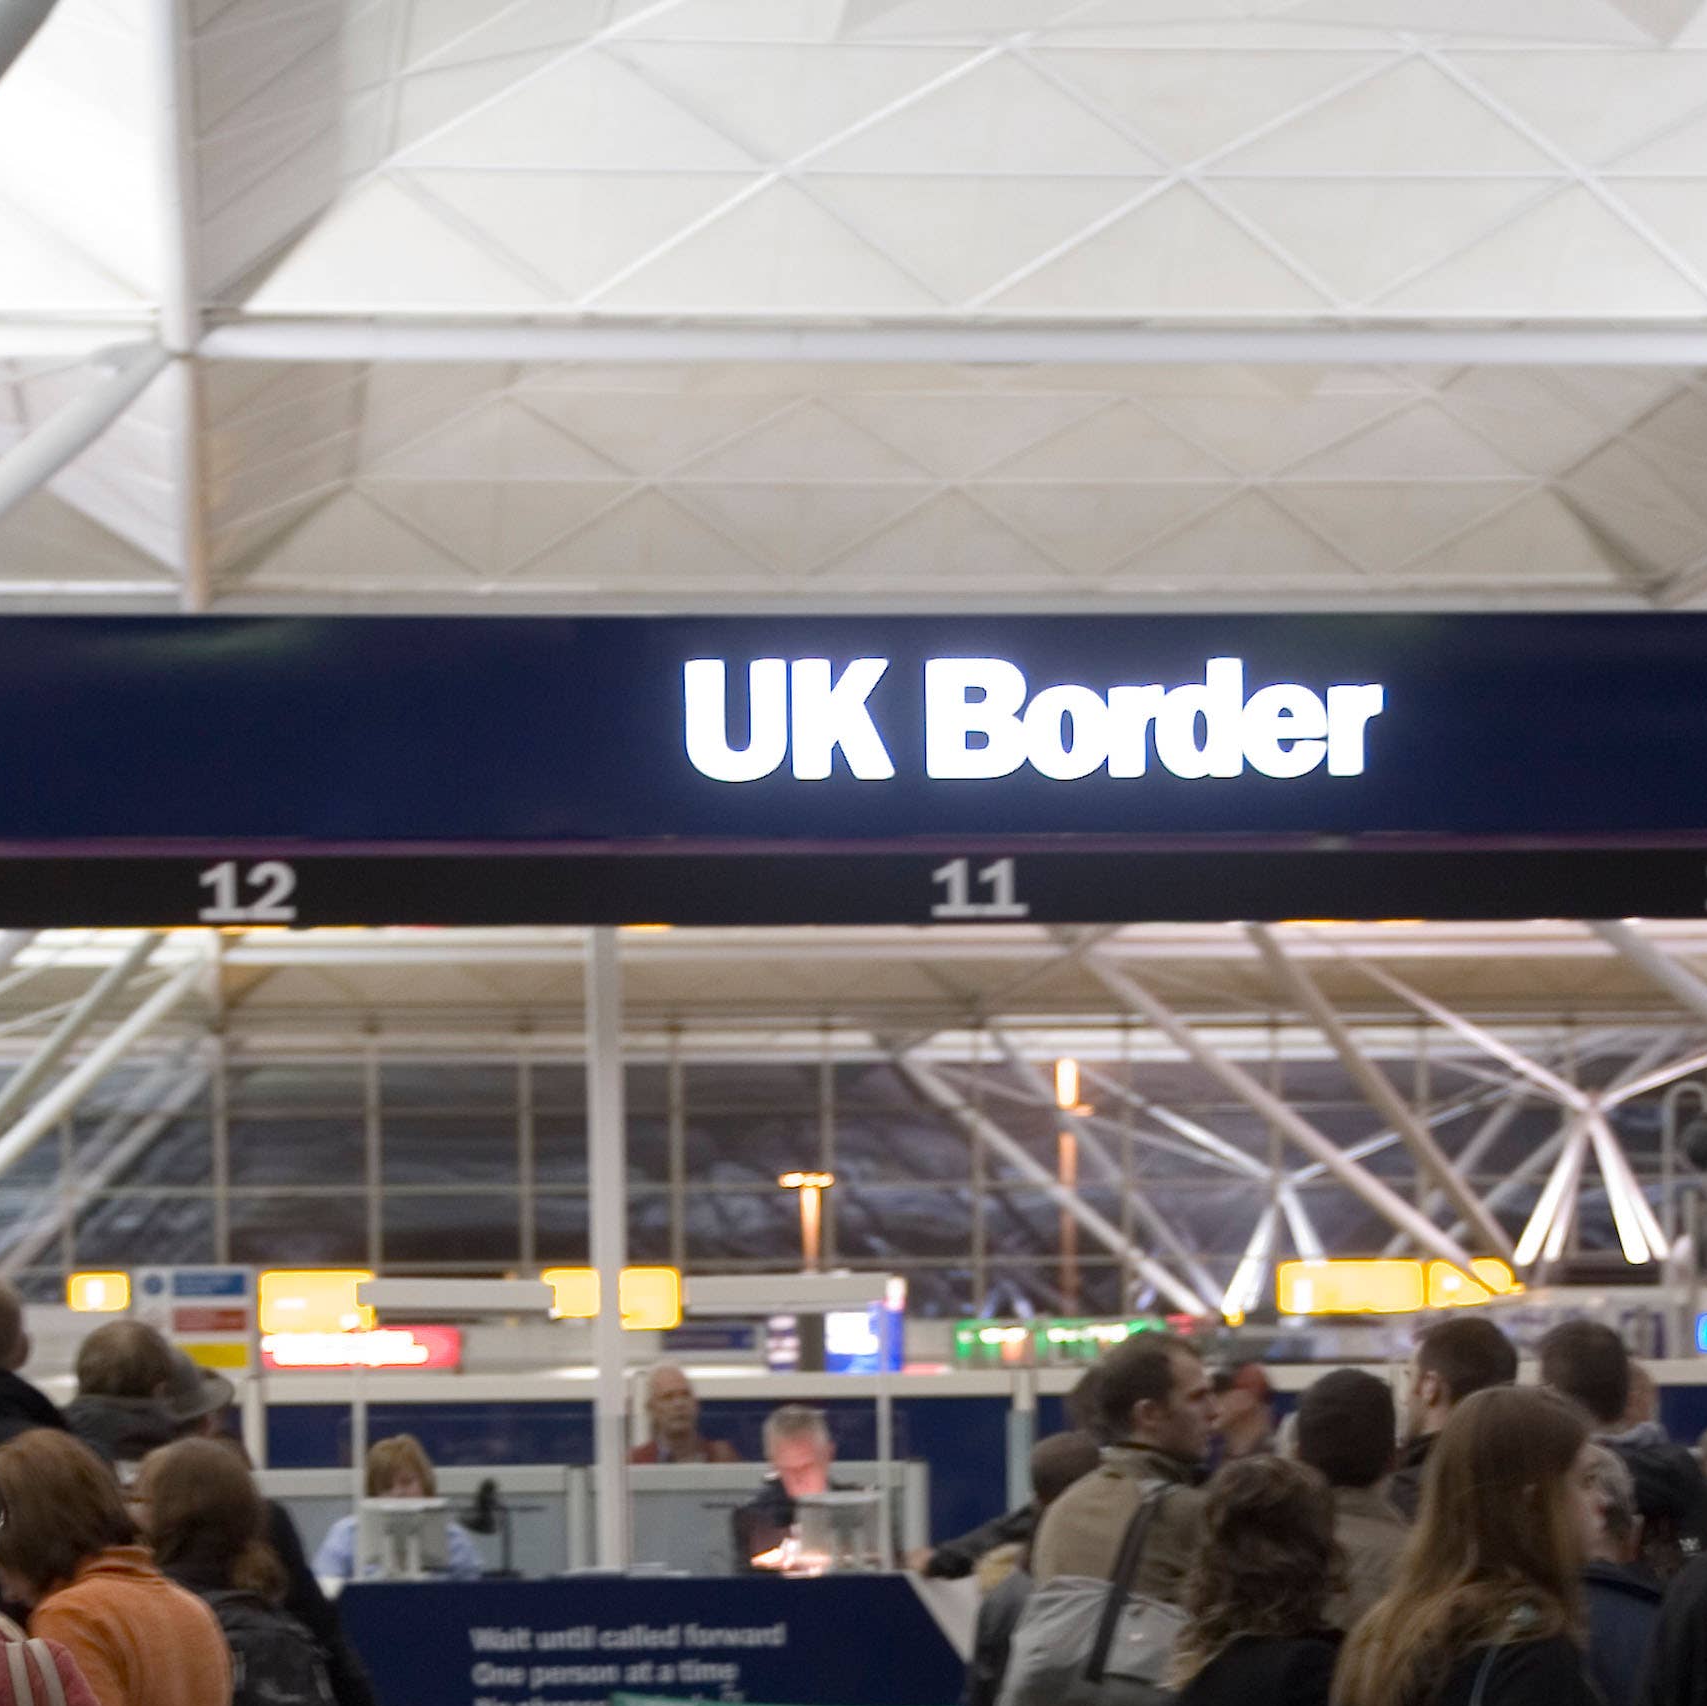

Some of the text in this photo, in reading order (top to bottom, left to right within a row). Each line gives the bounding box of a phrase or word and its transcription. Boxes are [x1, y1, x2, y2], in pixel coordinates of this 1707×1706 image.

[684, 656, 1385, 783] UK Border
[198, 860, 297, 923] 12
[930, 857, 1030, 919] 11
[469, 1622, 787, 1651] Wait until called forward
[470, 1658, 739, 1691] One person at a time
